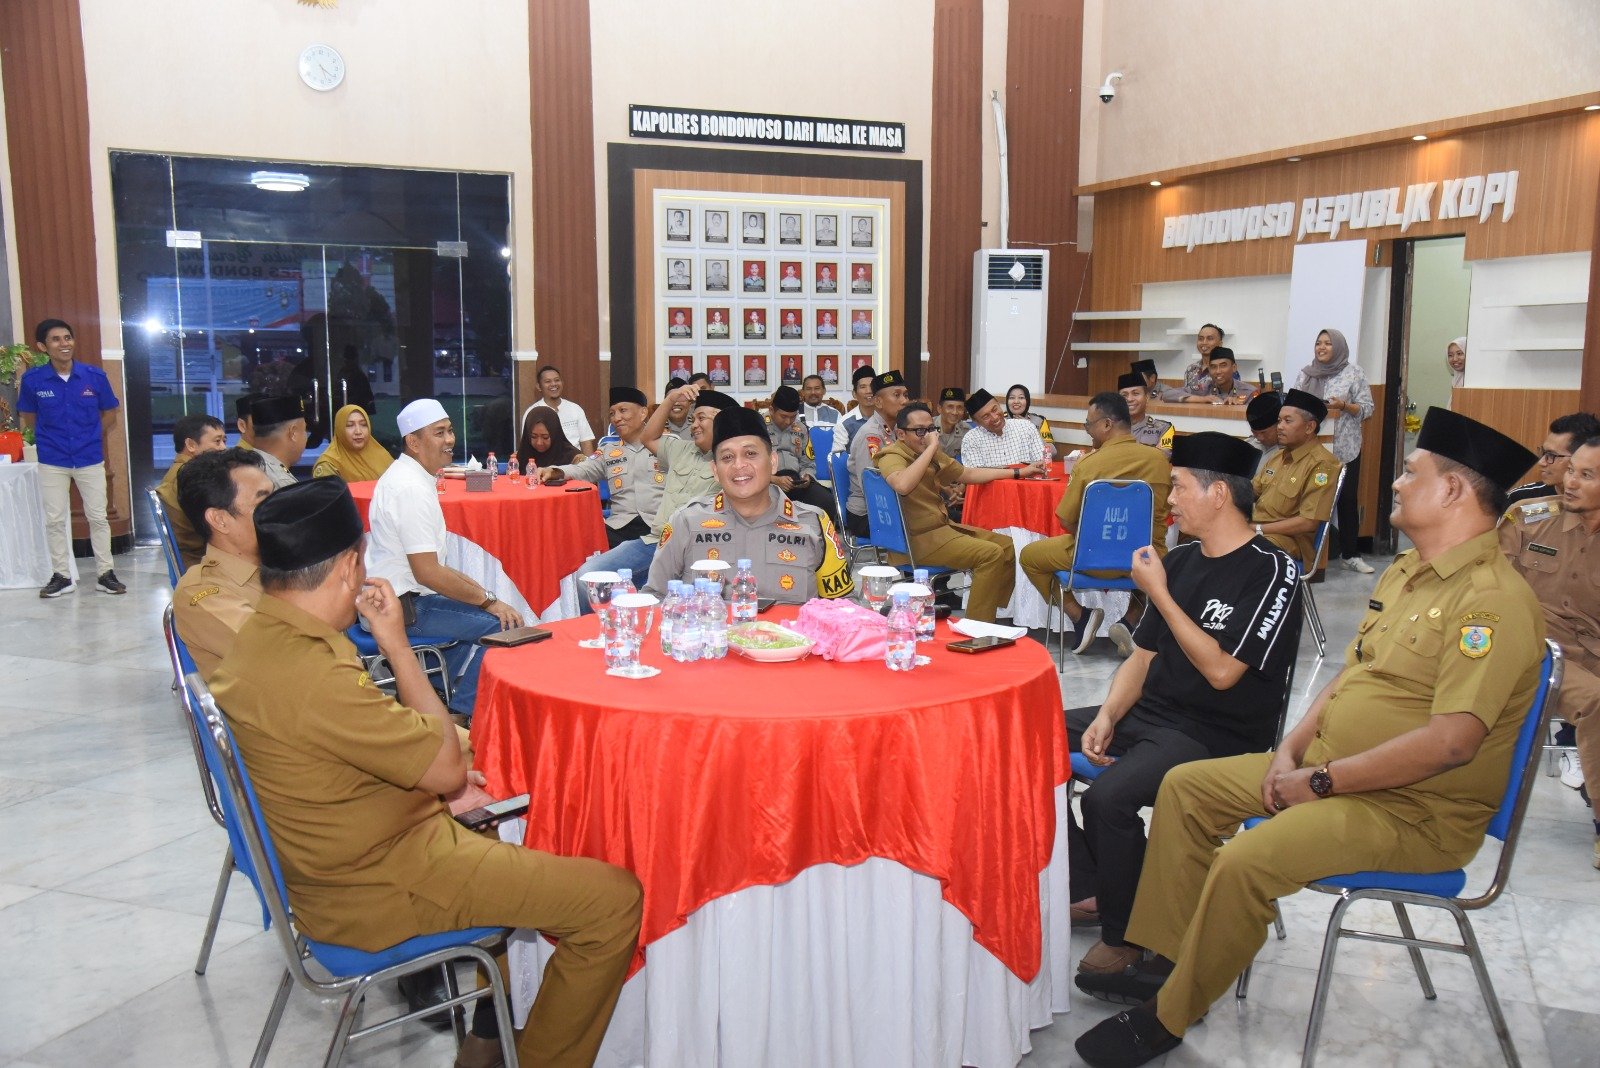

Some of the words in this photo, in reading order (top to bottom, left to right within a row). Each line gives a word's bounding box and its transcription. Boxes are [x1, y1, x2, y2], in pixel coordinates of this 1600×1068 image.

[632, 110, 699, 135] KAPOLRES
[700, 114, 782, 140] BONDOWOSO
[784, 120, 814, 142] DARI
[816, 122, 851, 144] MASA
[852, 124, 867, 145] KE
[868, 126, 903, 147] MASA
[1162, 201, 1296, 253] BONDOWOSO
[1297, 181, 1438, 242] REPUBLIK
[1438, 170, 1520, 224] KOPI
[1103, 506, 1128, 522] AULA
[695, 532, 732, 544] ARYO
[768, 532, 806, 546] POLRI
[1256, 587, 1288, 640] JATIM
